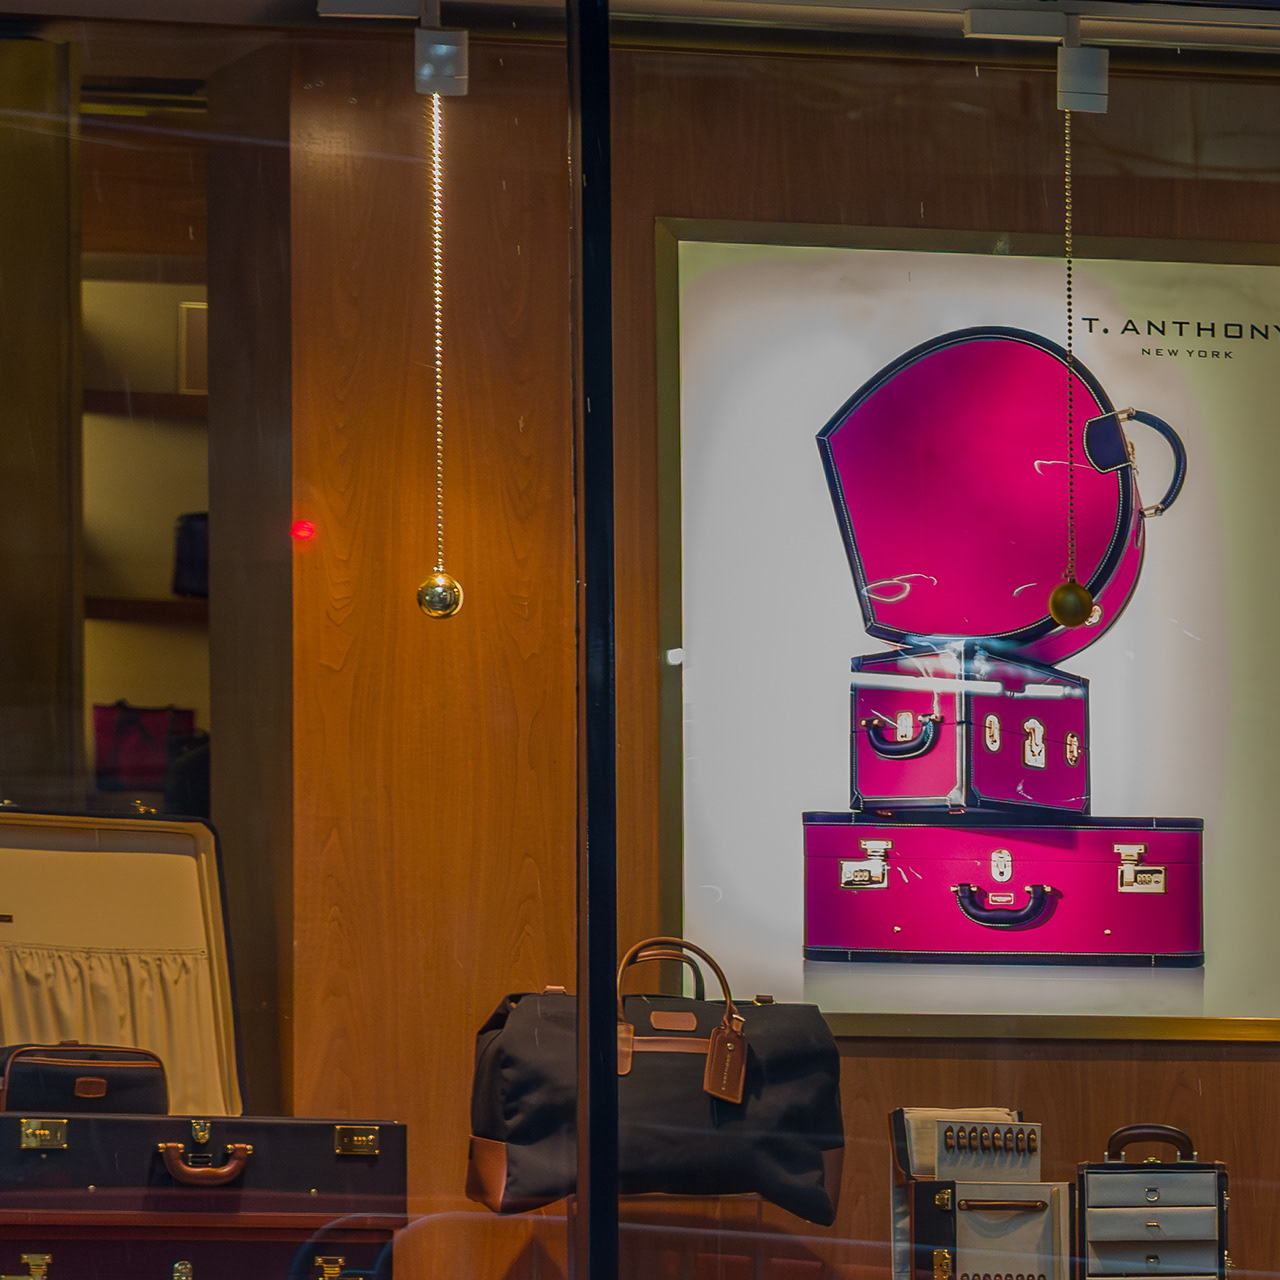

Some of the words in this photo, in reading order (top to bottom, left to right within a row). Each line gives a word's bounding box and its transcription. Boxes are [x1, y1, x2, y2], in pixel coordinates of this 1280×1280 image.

[1081, 317, 1109, 334] T.
[1141, 348, 1179, 357] NEW
[1186, 349, 1234, 359] YORK
